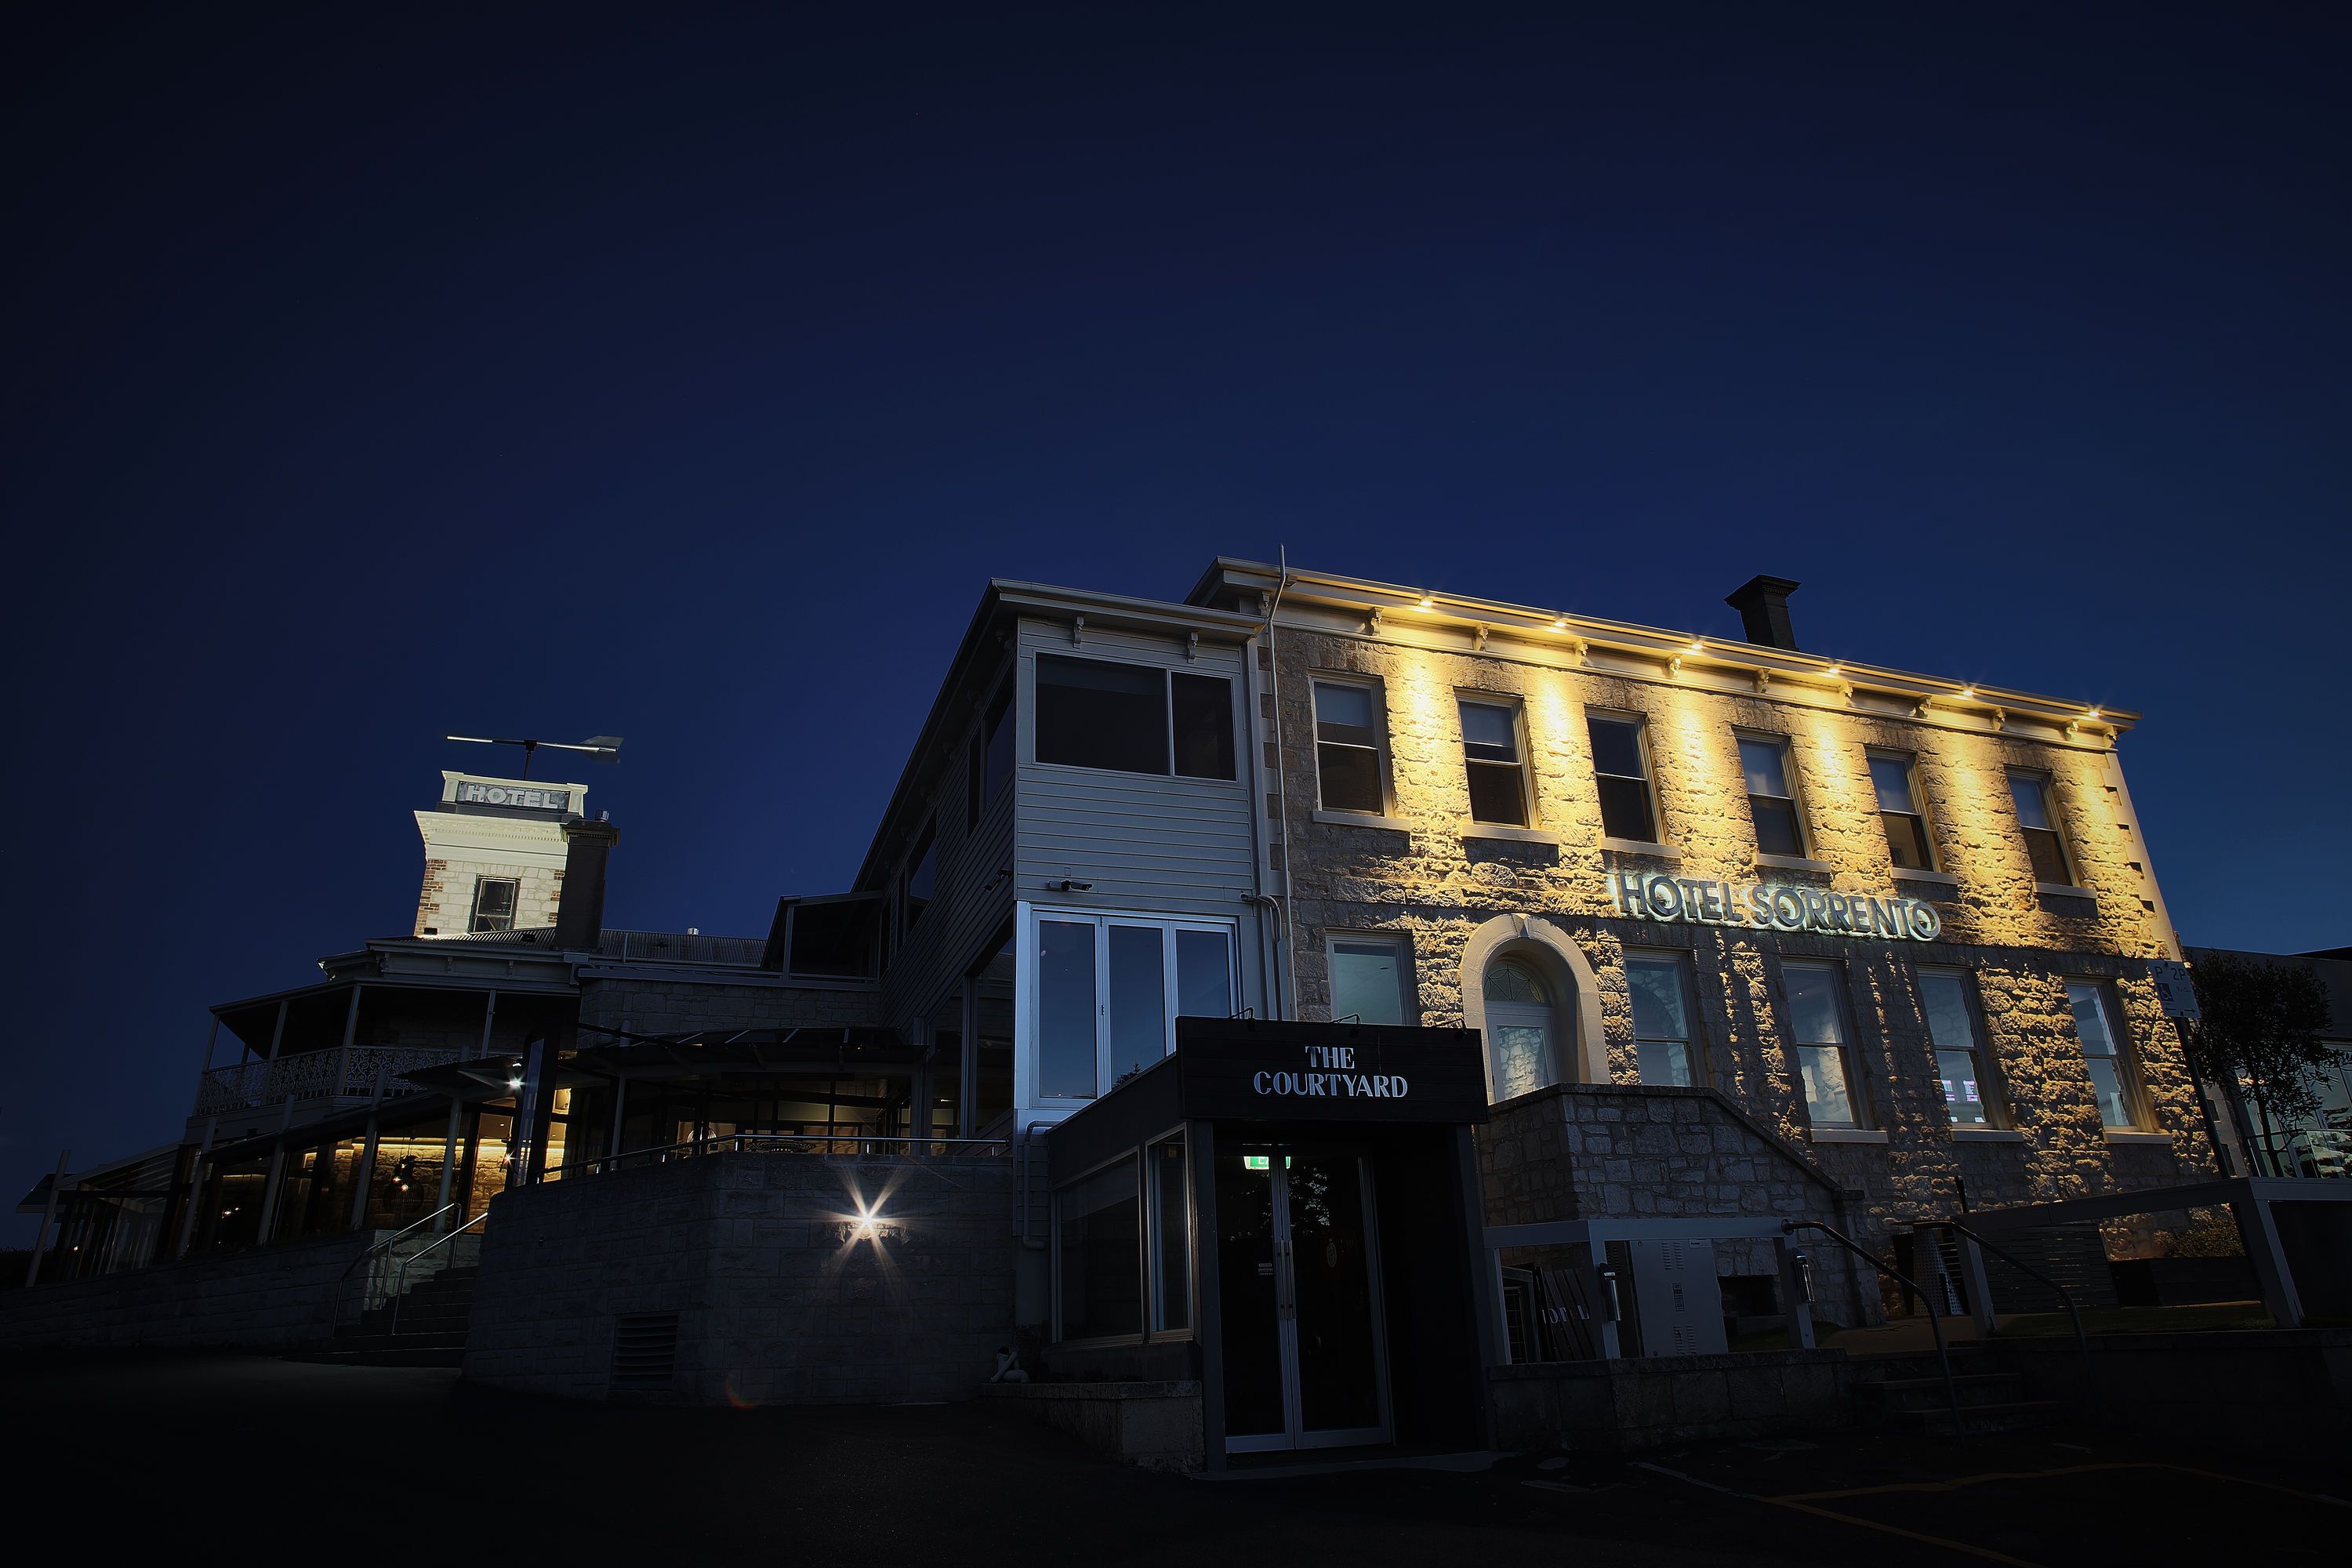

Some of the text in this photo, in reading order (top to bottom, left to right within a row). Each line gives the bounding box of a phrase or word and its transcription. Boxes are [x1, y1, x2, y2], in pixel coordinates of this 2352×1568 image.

[465, 785, 558, 808] HOTEL
[1617, 873, 1941, 938] HOTEL SORRENTO
[2154, 966, 2163, 978] P
[2171, 967, 2186, 980] 2P
[1305, 1046, 1355, 1069] THE
[1254, 1071, 1408, 1098] COURTYARD
